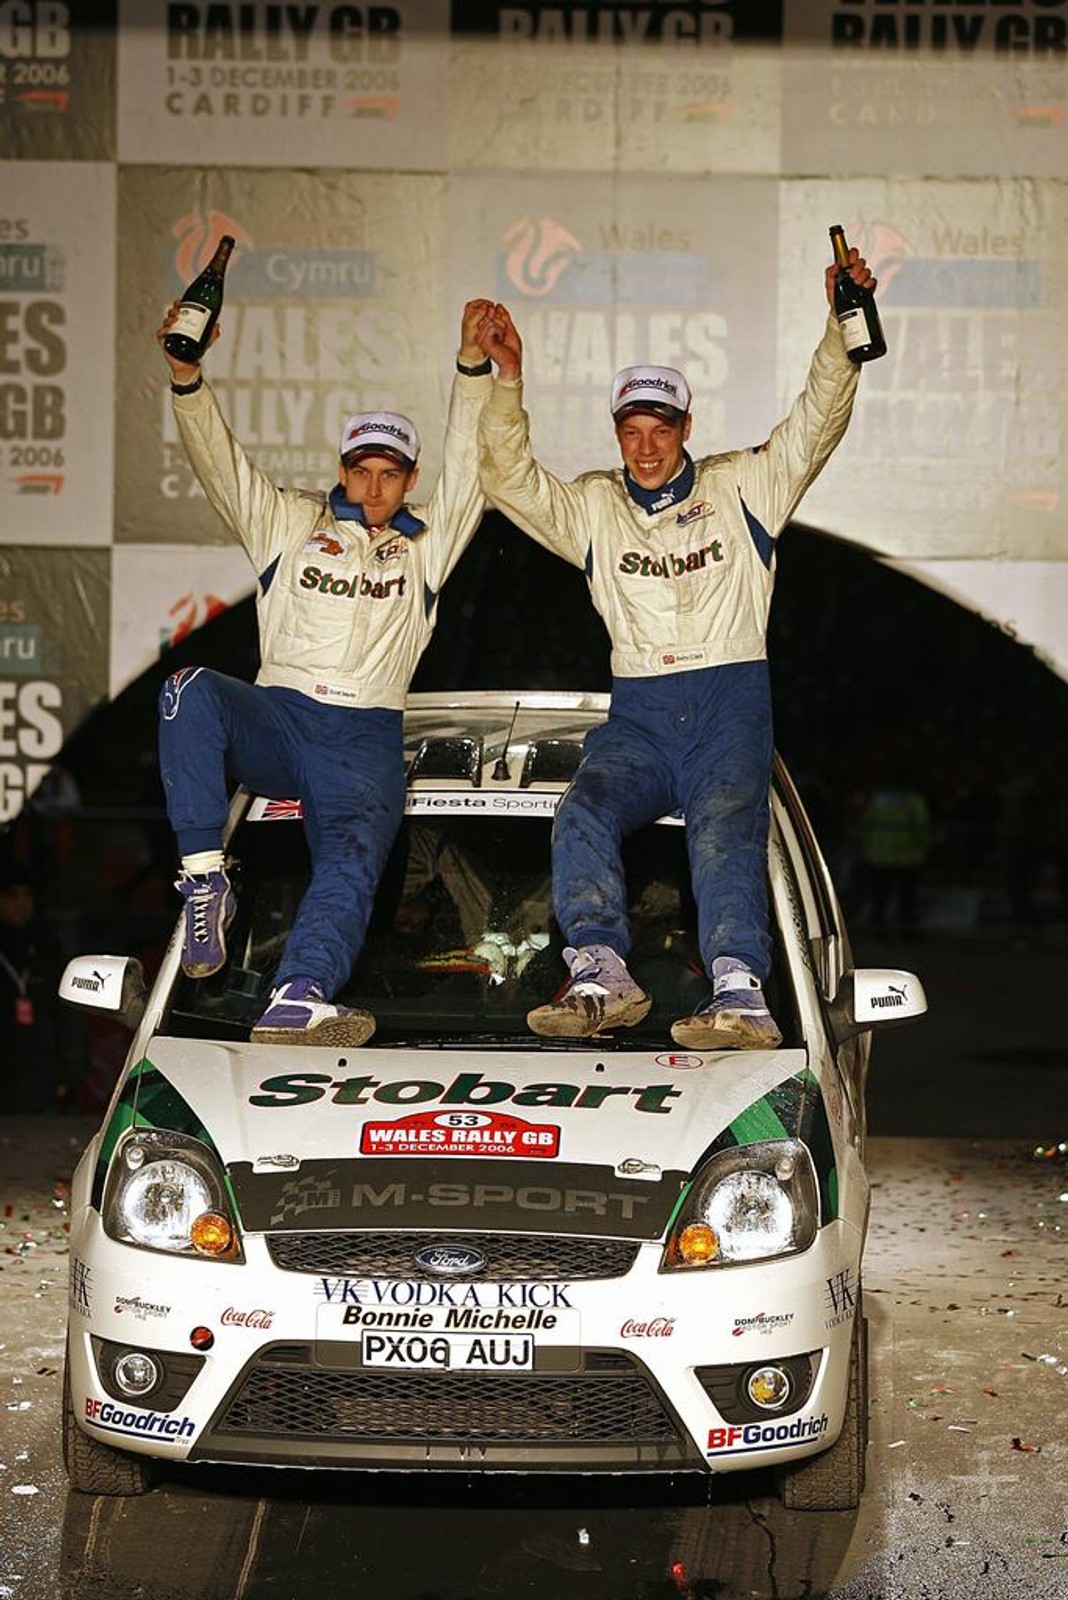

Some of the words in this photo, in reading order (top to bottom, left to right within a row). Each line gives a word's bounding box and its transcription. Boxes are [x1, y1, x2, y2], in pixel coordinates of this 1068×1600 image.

[167, 4, 318, 62] RALLY
[329, 6, 401, 64] GB
[13, 62, 71, 86] 2006
[167, 66, 203, 88] 1-3
[210, 68, 337, 89] DECEMBER
[345, 70, 400, 91] 2006
[165, 93, 336, 118] CARDIFF
[597, 223, 692, 251] Wales
[930, 226, 1025, 256] Wales
[266, 253, 371, 284] Cymru
[10, 448, 65, 467] 2006
[618, 539, 724, 579] Stobart
[299, 566, 406, 599] Stobart
[413, 797, 486, 808] Fiesta
[870, 995, 902, 1009] PUMA
[248, 1072, 682, 1114] Stobart
[448, 1115, 480, 1126] 53
[369, 1129, 446, 1144] WALES
[451, 1130, 518, 1145] RALLY
[521, 1131, 554, 1146] GB
[370, 1143, 394, 1152] 1-3
[398, 1143, 475, 1153] DECEMBER
[478, 1144, 516, 1153] 2006
[352, 1182, 649, 1220] M-SPORT
[429, 1249, 469, 1267] Ford
[320, 1278, 363, 1304] VK
[372, 1281, 482, 1308] VODKA
[498, 1284, 572, 1308] KICK
[342, 1304, 434, 1328] Bonnie
[444, 1308, 558, 1330] Michelle
[465, 1338, 530, 1366] AUJ
[85, 1397, 196, 1437] BFGoodrich
[707, 1412, 829, 1449] BFGoodrich
